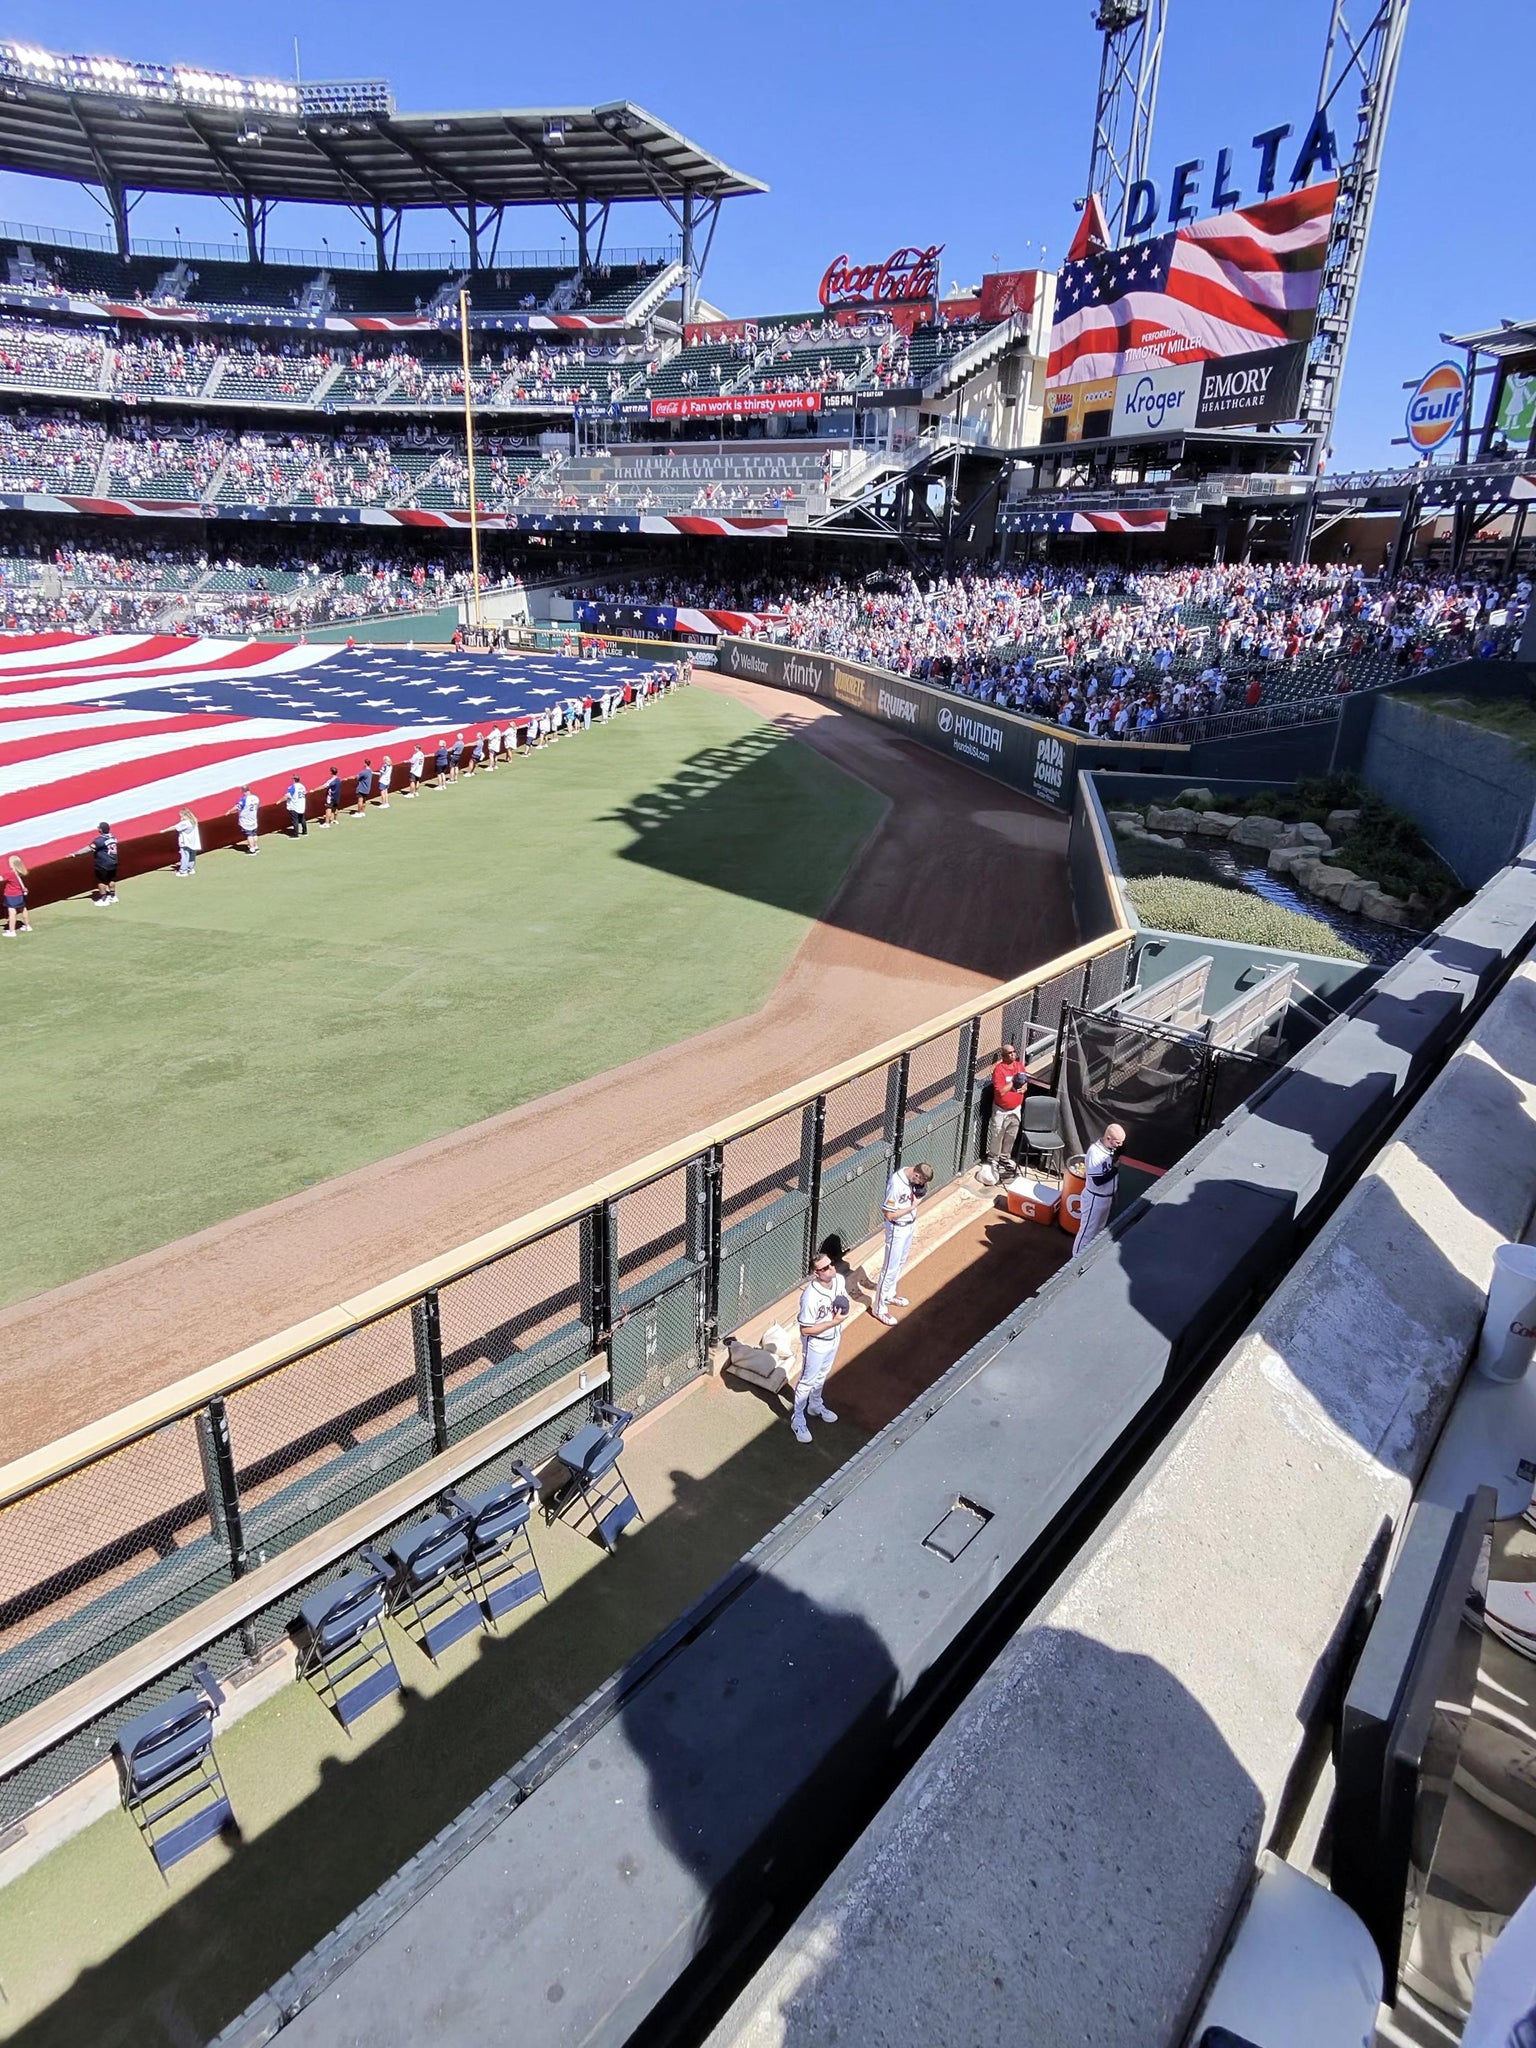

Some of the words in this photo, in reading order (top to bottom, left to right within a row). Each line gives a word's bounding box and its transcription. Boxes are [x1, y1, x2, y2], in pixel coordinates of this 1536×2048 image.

[1124, 109, 1338, 237] DELTA
[819, 244, 946, 306] Coca-Cola
[1125, 344, 1166, 361] TIMOTHY
[1167, 336, 1202, 354] MILLER
[1141, 329, 1177, 343] PERFORMED
[1203, 366, 1274, 399] EMORY
[690, 403, 706, 412] Fan
[707, 400, 732, 411] work
[734, 400, 742, 410] is
[743, 398, 777, 412] thirsty
[778, 397, 803, 409] work
[841, 394, 853, 406] PM
[1125, 376, 1186, 429] Kroger
[1201, 395, 1265, 412] HEALTHCARE
[1410, 391, 1463, 422] Gulf
[614, 457, 673, 479] HANK
[724, 456, 821, 478] TERRACE
[740, 653, 769, 674] Wellstar
[783, 656, 822, 692] xfinity
[878, 689, 916, 724] EQUIFAX
[955, 715, 1003, 752] HYUNDAI
[1036, 738, 1064, 769] PAPA
[1033, 761, 1063, 788] JOHNS
[1021, 1201, 1036, 1217] G
